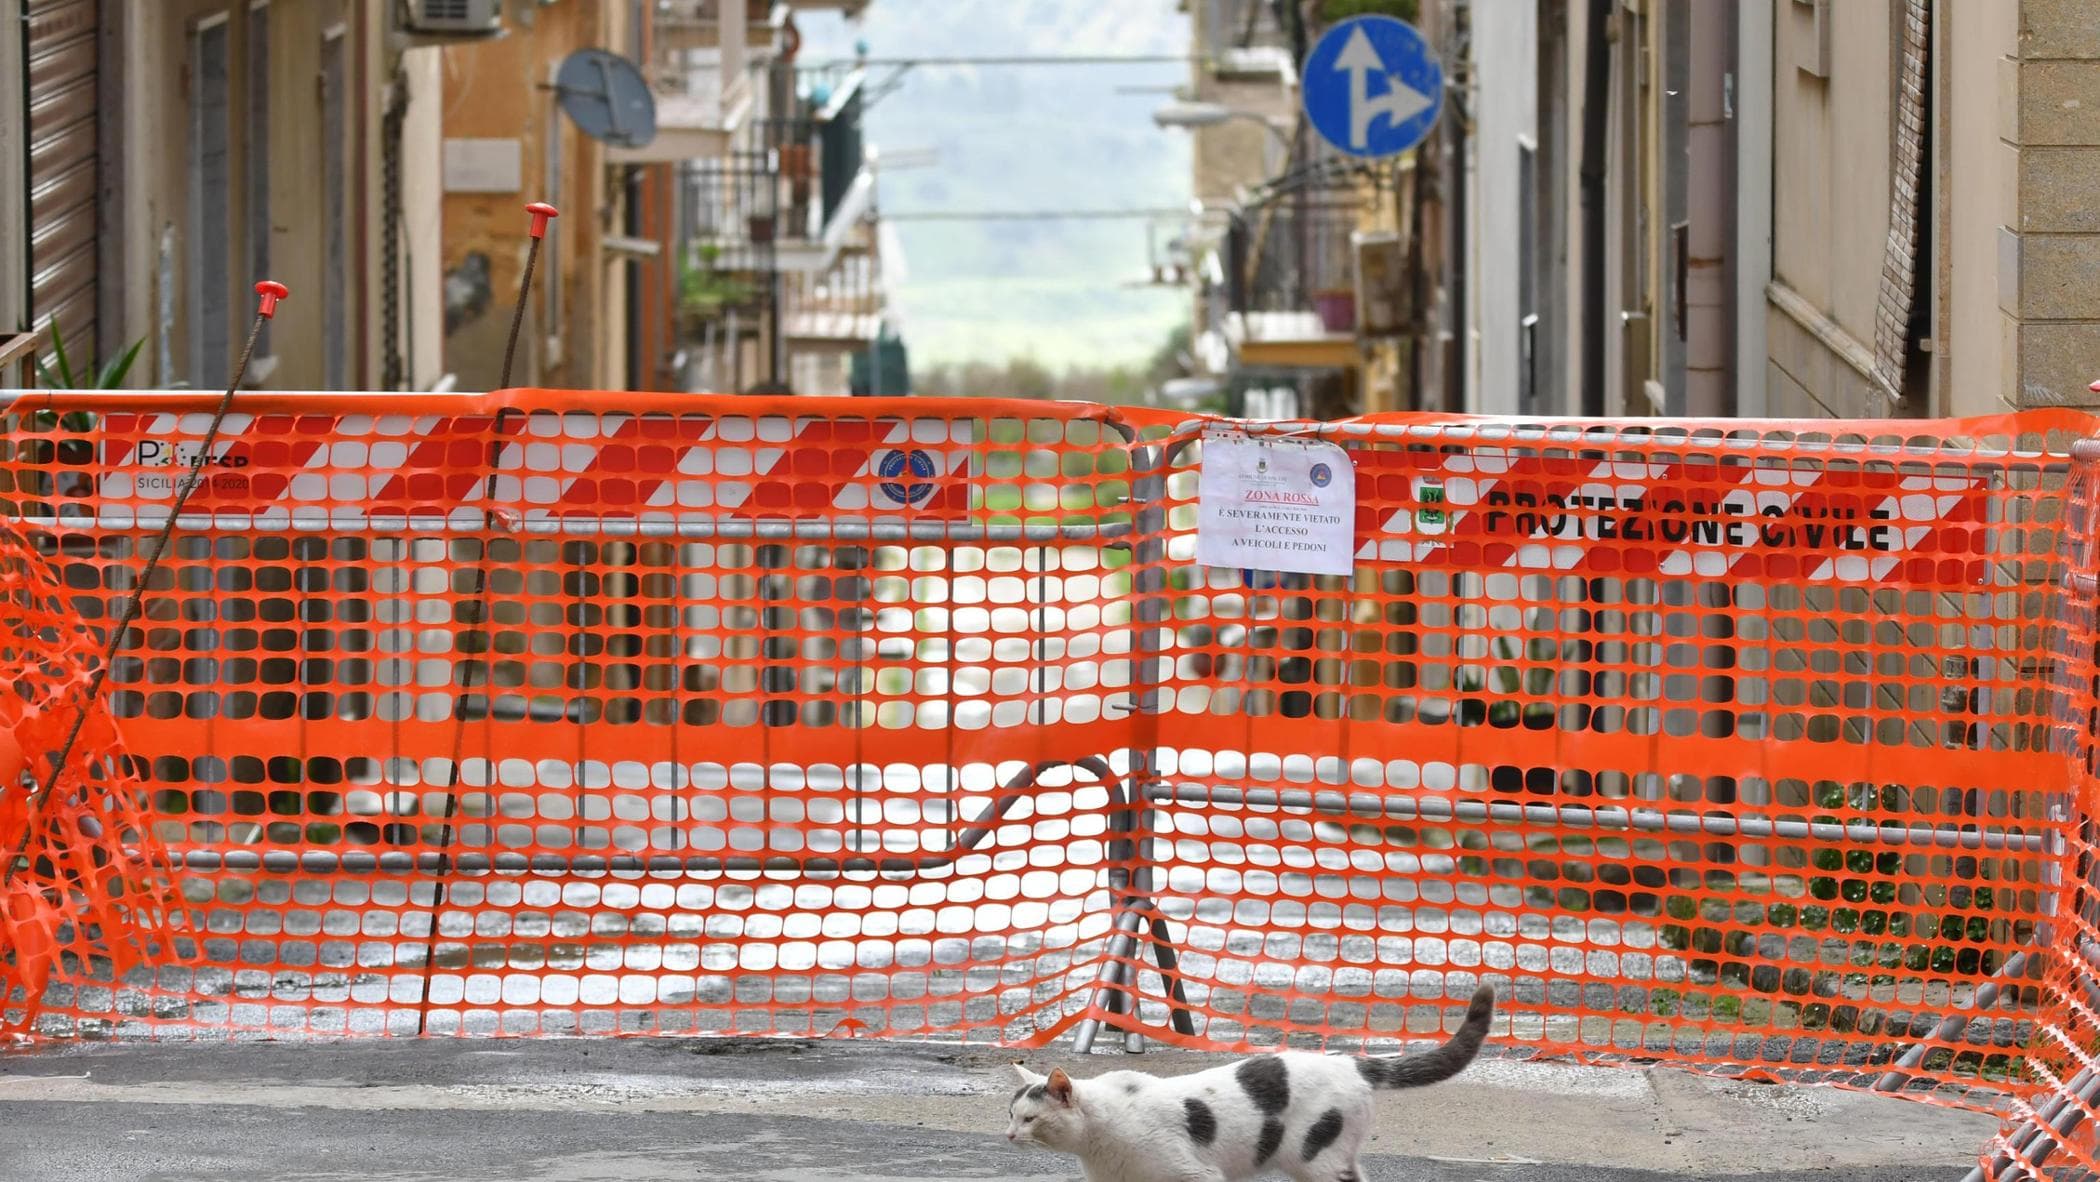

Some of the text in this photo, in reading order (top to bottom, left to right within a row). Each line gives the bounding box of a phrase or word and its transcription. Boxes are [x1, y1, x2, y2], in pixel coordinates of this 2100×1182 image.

[138, 478, 187, 489] SICILIA
[1245, 490, 1319, 504] ZONA ROSSA
[1227, 508, 1301, 522] SEVERAMENTE
[1303, 514, 1341, 525] VIETATO
[1488, 491, 1890, 552] PROTEZIONE CIVILE
[1231, 538, 1328, 552] A VEICOLI E PEDONI
